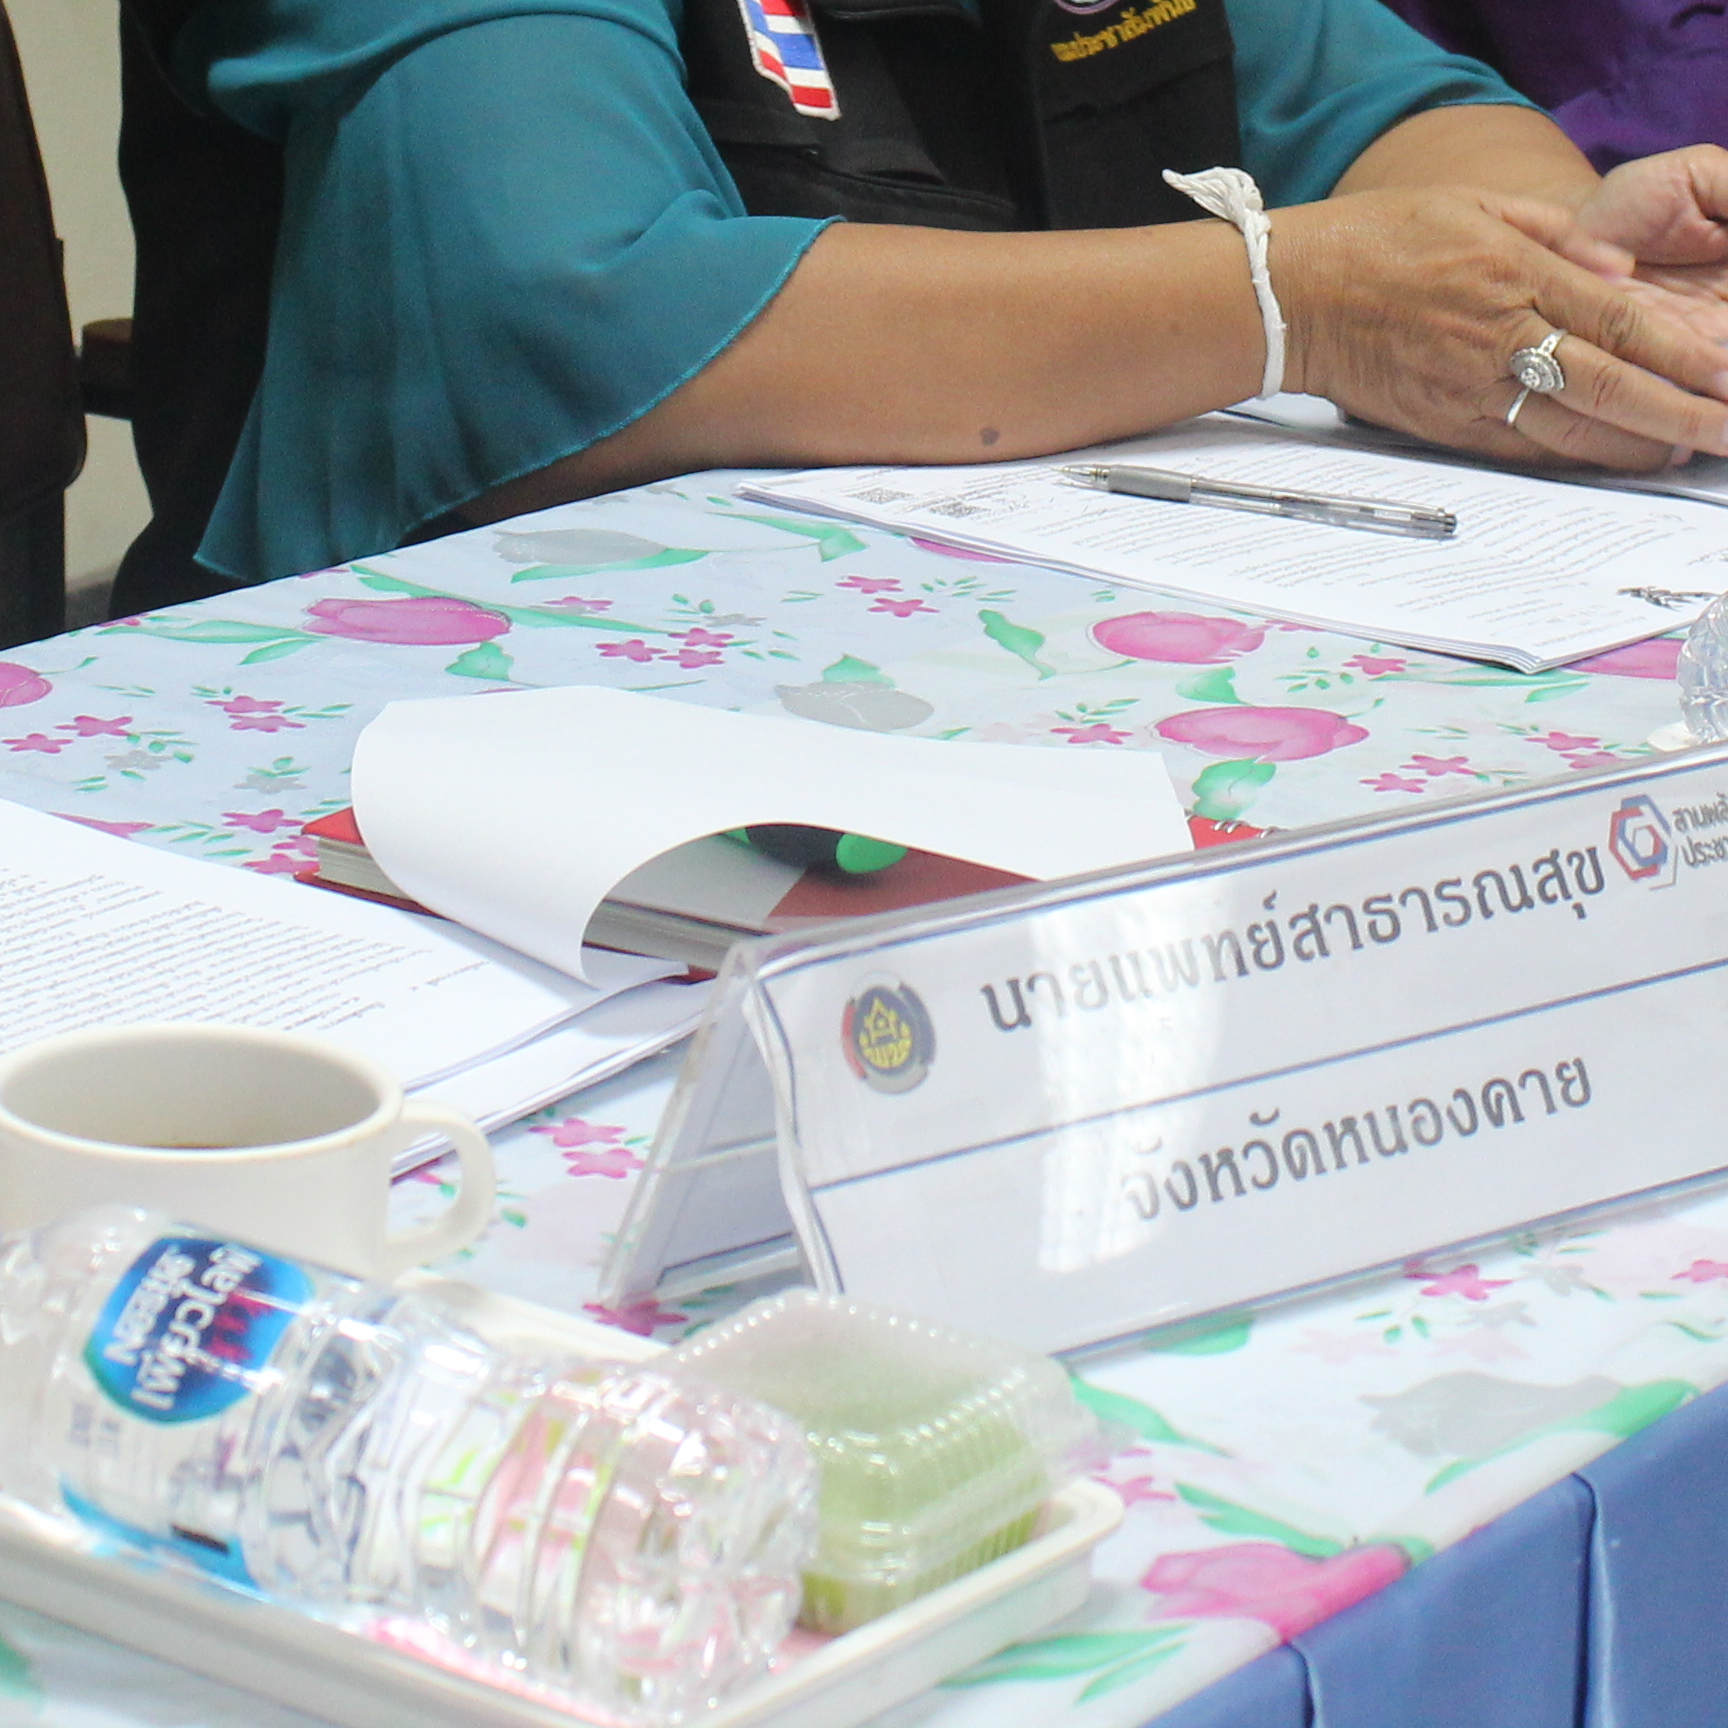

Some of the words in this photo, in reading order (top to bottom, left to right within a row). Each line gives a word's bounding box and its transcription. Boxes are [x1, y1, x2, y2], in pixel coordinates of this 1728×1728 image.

[980, 845, 1606, 1032] นายแพทย์สาธารณสุข
[1122, 1056, 1593, 1222] จังหวัดหนองคาย
